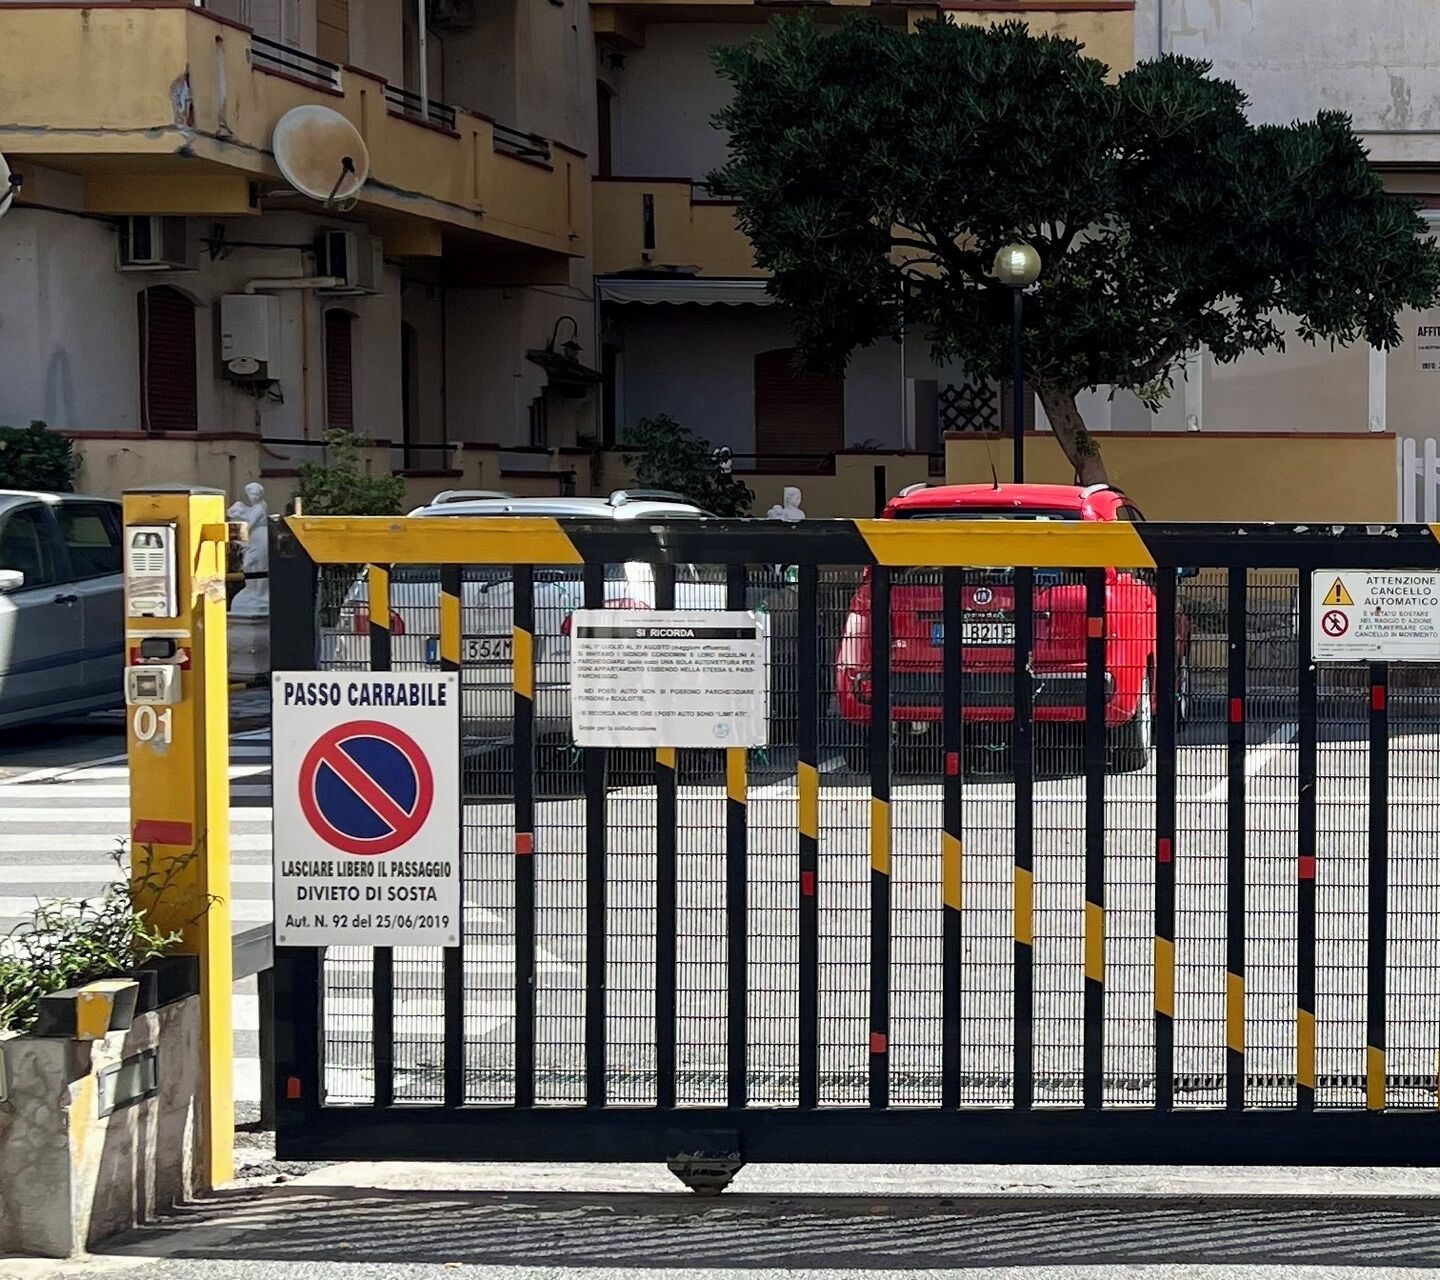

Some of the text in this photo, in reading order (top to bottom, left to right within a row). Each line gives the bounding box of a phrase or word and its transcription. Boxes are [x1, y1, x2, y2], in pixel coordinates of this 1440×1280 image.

[1366, 577, 1436, 585] ATTENZIONE
[1371, 587, 1432, 595] CANCELLO
[1364, 597, 1438, 606] AUTOMATICO
[635, 628, 696, 638] SI RICORDA
[284, 682, 447, 706] PASSO CARRABILE
[133, 704, 173, 744] 01
[281, 861, 451, 877] LASCIARE LIBERO IL PASSAGGIO
[297, 886, 438, 901] DIVIETO DI SOSTA
[285, 914, 450, 930] Aut. N. 92 del 25/06/2019
